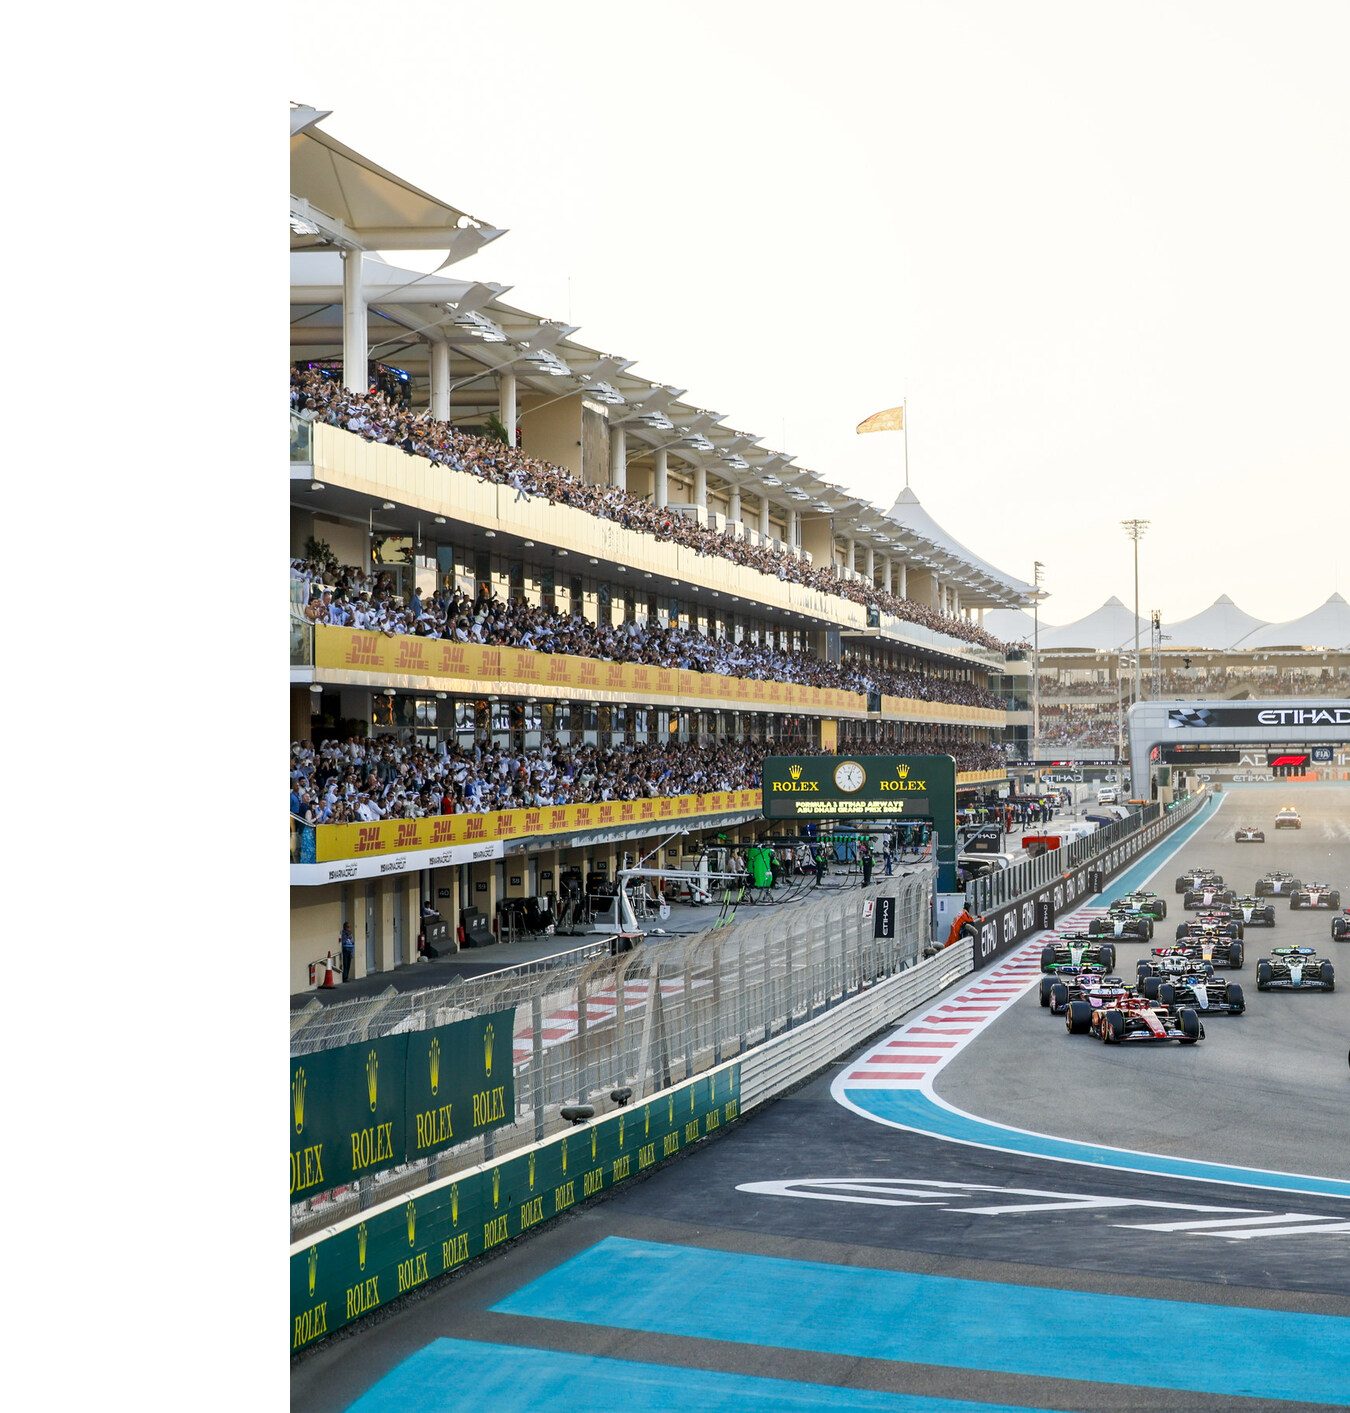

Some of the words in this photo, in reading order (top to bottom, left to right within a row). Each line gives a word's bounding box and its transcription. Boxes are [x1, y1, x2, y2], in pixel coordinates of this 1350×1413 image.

[351, 635, 379, 666] DHL
[399, 640, 424, 669] DHL
[443, 646, 465, 674] DHL
[481, 650, 502, 676] DHL
[517, 654, 536, 679] DHL
[550, 658, 567, 682] DHL
[580, 662, 596, 685] DHL
[772, 782, 819, 791] ROLEX
[880, 781, 926, 790] ROLEX
[1232, 774, 1276, 782] ETIHAD
[497, 815, 514, 836] DHL
[526, 813, 541, 832] DHL
[552, 810, 567, 829] DHL
[576, 808, 591, 826] DHL
[600, 806, 613, 824] DHL
[622, 804, 634, 821] DHL
[359, 827, 382, 852] DHL
[398, 824, 420, 846] DHL
[433, 820, 454, 843] DHL
[466, 818, 484, 839] DHL
[981, 920, 997, 957] ETIHAD
[1004, 909, 1017, 942] ETIHAD
[473, 1086, 505, 1127] ROLEX
[416, 1104, 453, 1149] ROLEX
[685, 1119, 699, 1143] ROLEX
[351, 1122, 393, 1170] ROLEX
[638, 1143, 655, 1169] ROLEX
[664, 1131, 679, 1156] ROLEX
[584, 1167, 603, 1196] ROLEX
[613, 1155, 630, 1182] ROLEX
[555, 1181, 575, 1212] ROLEX
[520, 1196, 543, 1230] ROLEX
[484, 1214, 508, 1249] ROLEX
[442, 1233, 469, 1269] ROLEX
[398, 1252, 429, 1292] ROLEX
[346, 1276, 380, 1320] ROLEX
[294, 1302, 327, 1349] ROLEX
